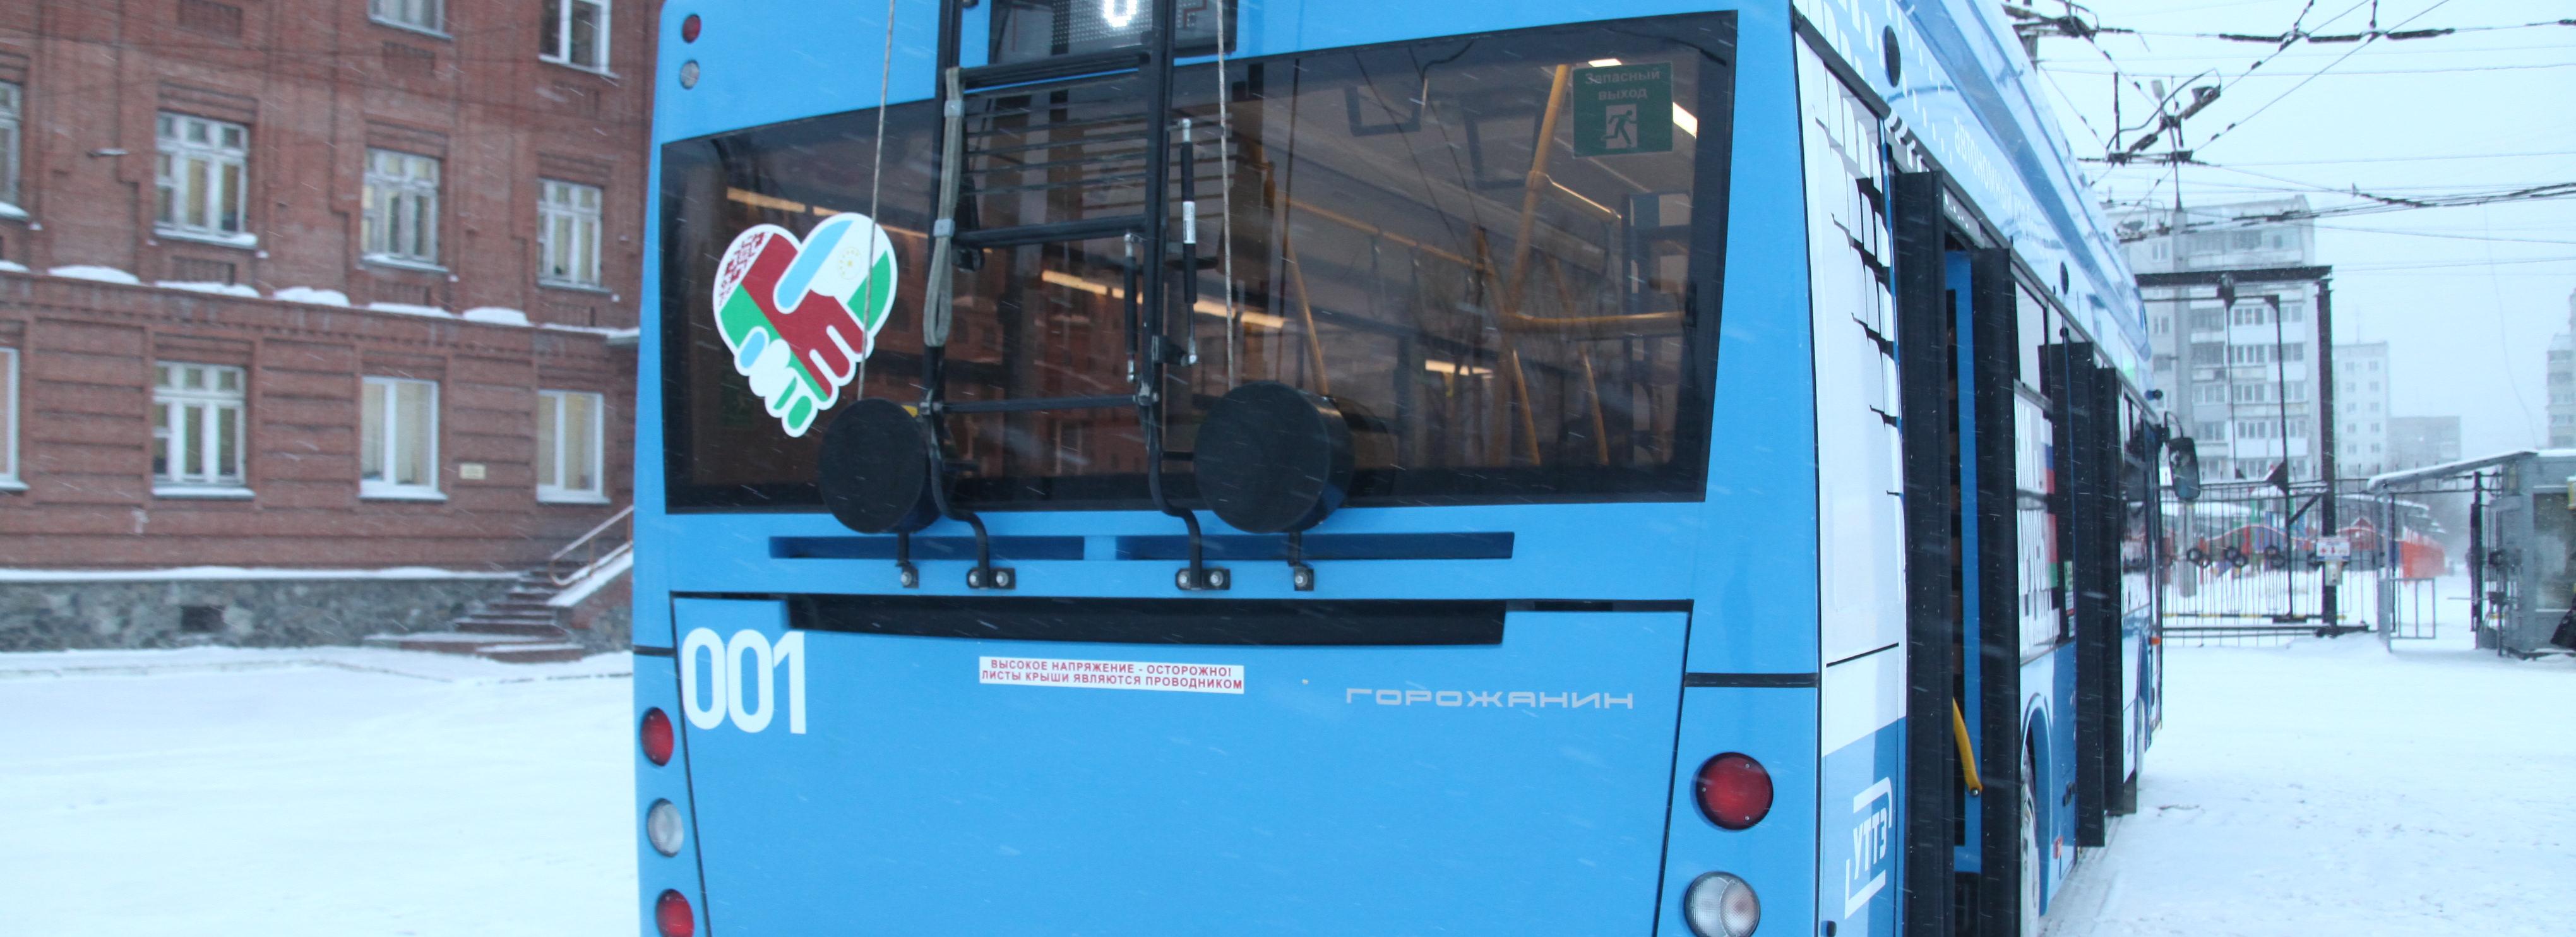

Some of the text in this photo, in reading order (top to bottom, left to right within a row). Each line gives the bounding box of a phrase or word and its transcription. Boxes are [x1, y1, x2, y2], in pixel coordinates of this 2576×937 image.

[1585, 68, 1661, 84] Запасный
[1598, 88, 1647, 101] выход
[991, 659, 1047, 671] ВЫСОКОЕ
[1052, 662, 1135, 674] НАПРЯЖЕНИЕ
[1147, 664, 1232, 677] ОСТОРОЖНО!
[681, 627, 806, 734] 001
[982, 670, 1242, 689] ЛИСТЫ КРЫШИ ЯВЛЯЮТСЯ ПРОВОДНИКОМ
[1346, 688, 1633, 709] ГОРОЖАНИН
